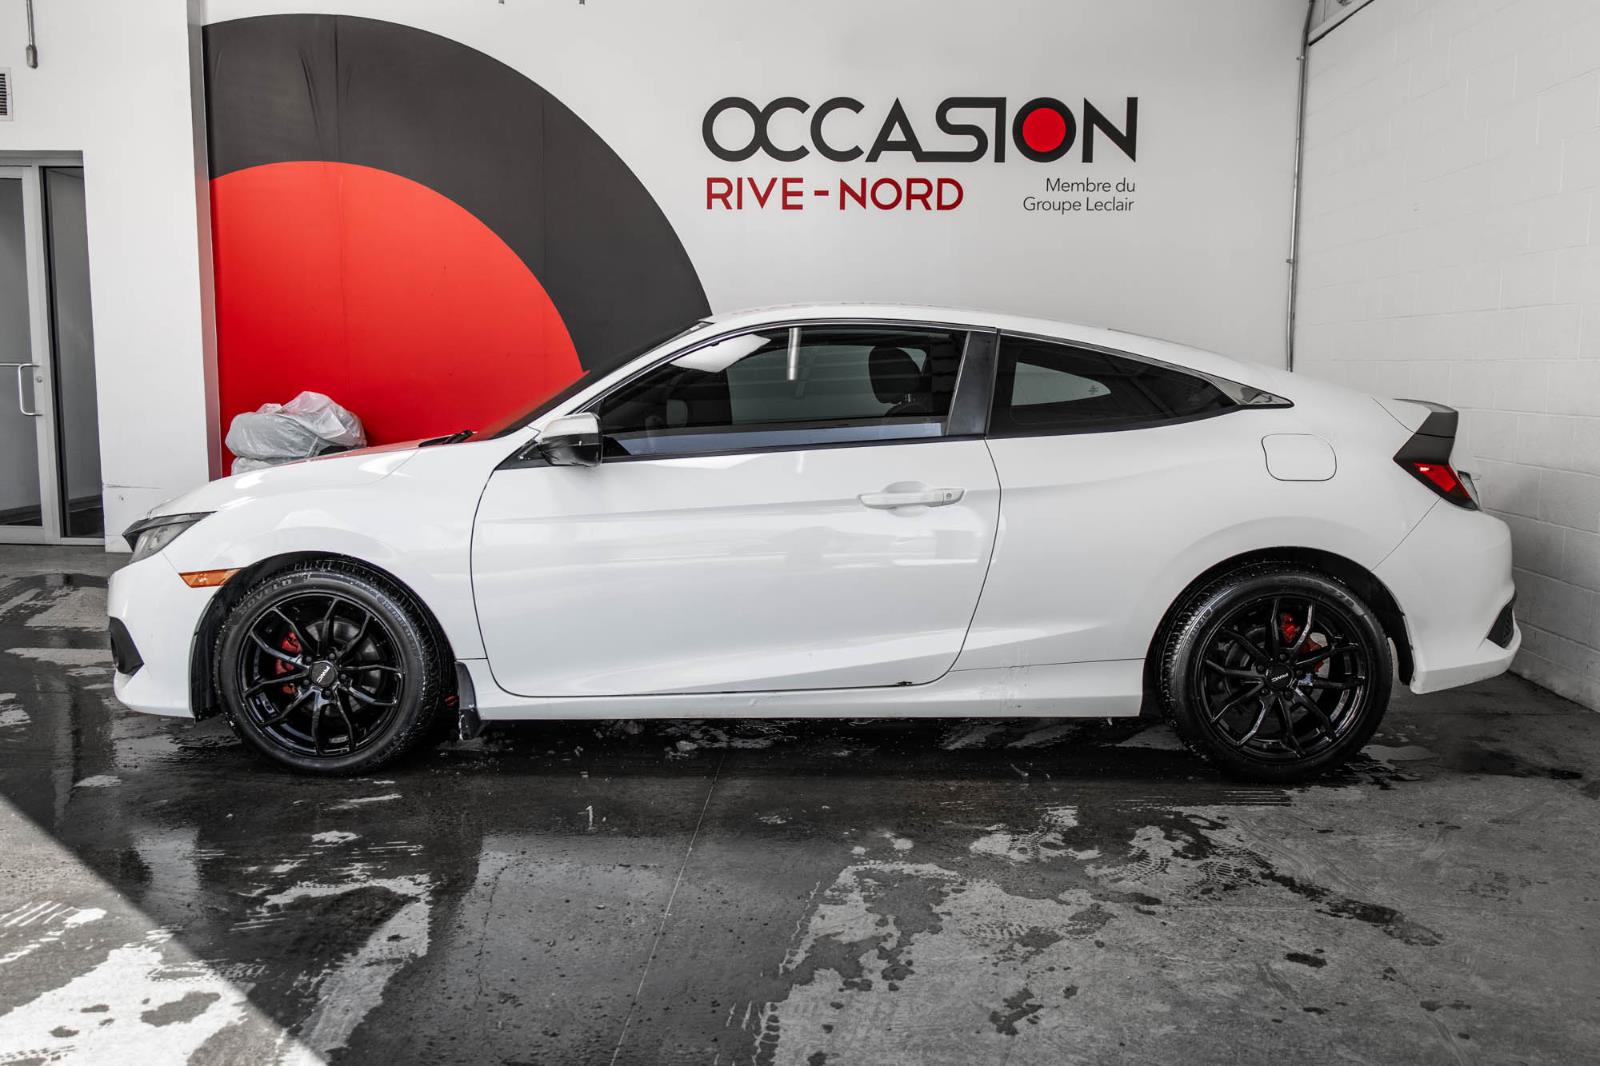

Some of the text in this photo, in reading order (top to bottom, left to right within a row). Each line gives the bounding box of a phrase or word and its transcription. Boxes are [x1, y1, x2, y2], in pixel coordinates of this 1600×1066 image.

[702, 96, 1138, 163] OCCASION
[1046, 177, 1135, 192] Membre du
[1023, 196, 1135, 215] Groupe Leclair
